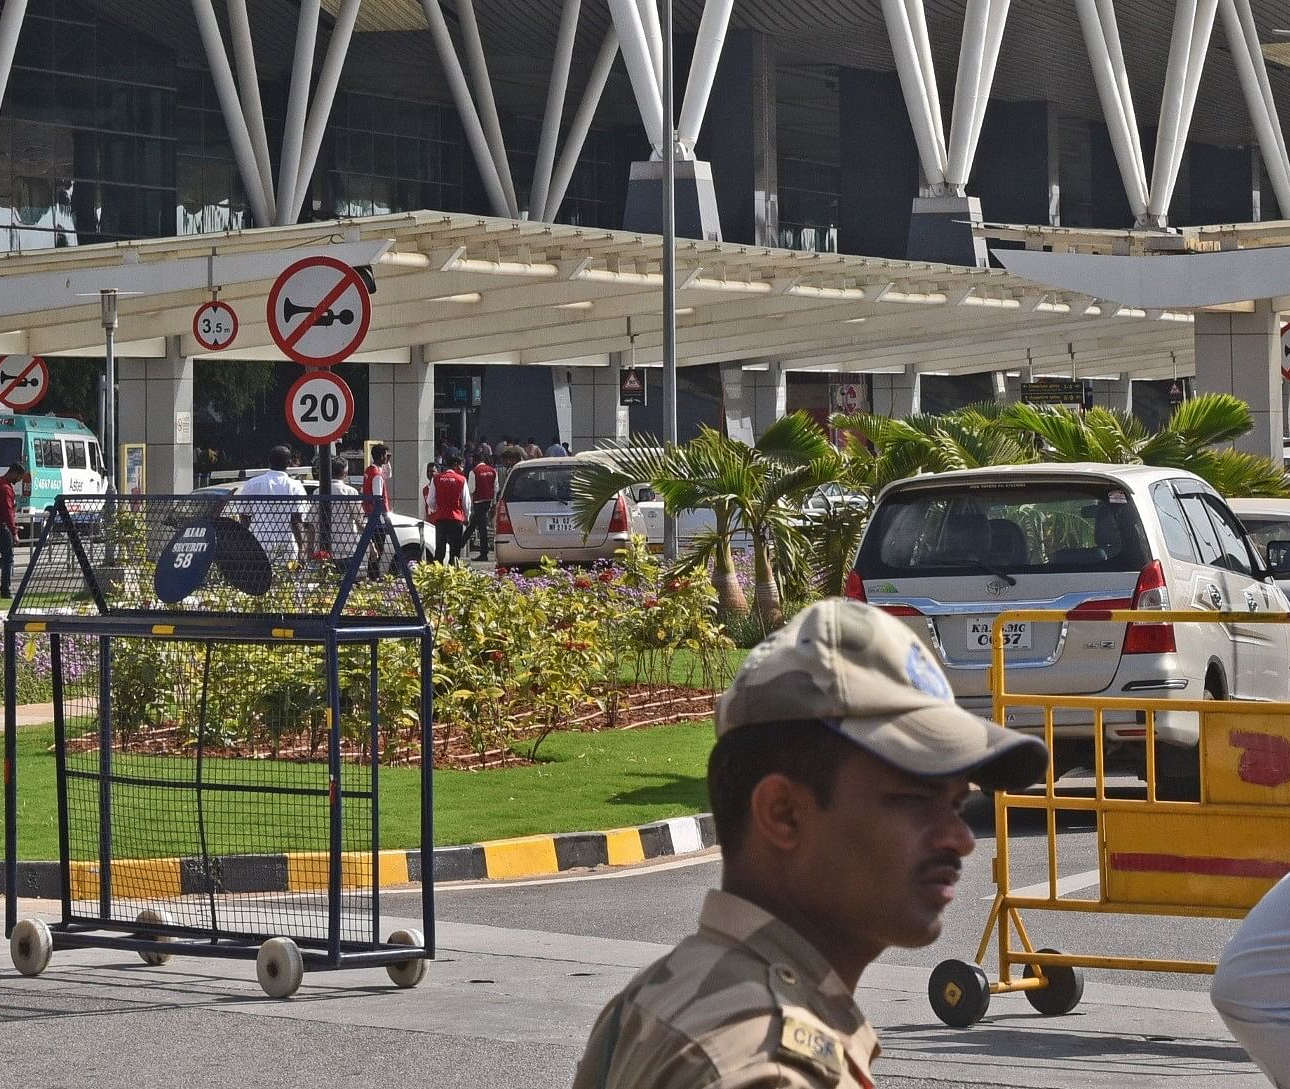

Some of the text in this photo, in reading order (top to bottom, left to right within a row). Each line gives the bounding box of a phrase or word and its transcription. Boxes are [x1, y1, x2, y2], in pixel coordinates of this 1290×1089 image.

[299, 393, 339, 423] 20
[69, 478, 84, 493] Aster
[172, 542, 209, 553] SECURITY
[173, 553, 193, 569] 58
